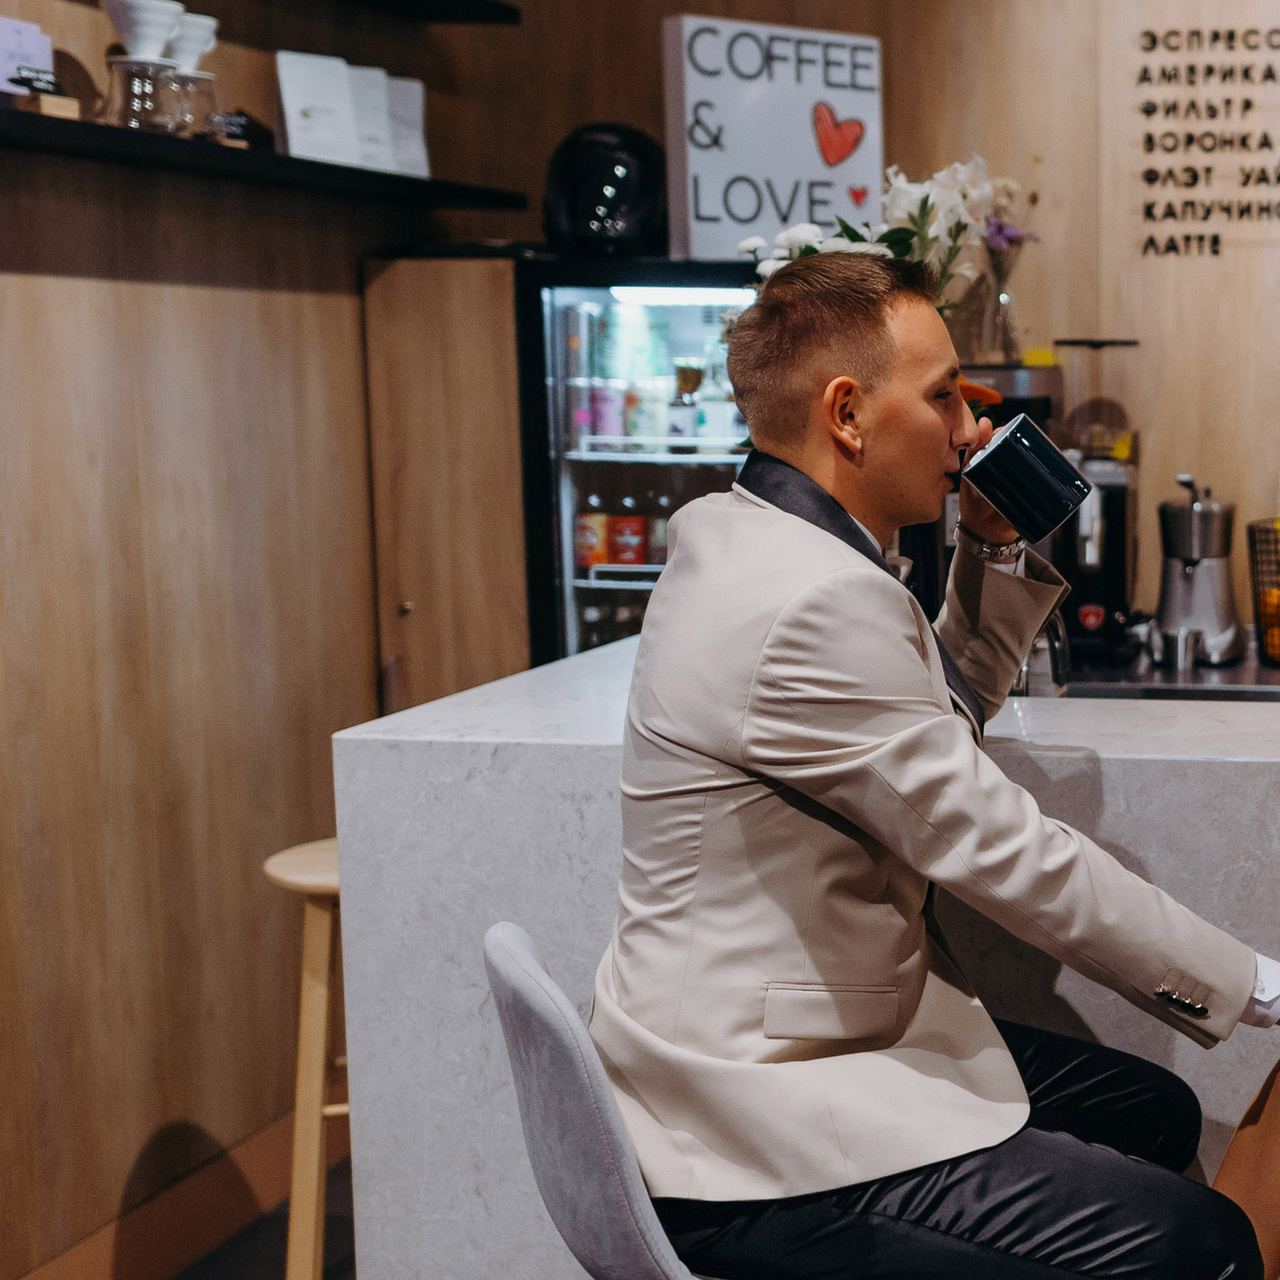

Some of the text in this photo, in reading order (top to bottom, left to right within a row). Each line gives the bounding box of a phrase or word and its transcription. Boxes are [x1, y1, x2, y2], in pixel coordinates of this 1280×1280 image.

[687, 25, 876, 92] COFFEE
[1139, 97, 1255, 121] ФИЛЬТР
[687, 100, 725, 150] &
[1142, 131, 1274, 155] ВОРОНКА
[1140, 165, 1214, 189] ФЛЭТ
[692, 176, 836, 227] LOVE
[1141, 233, 1222, 257] ЛАТТЕ
